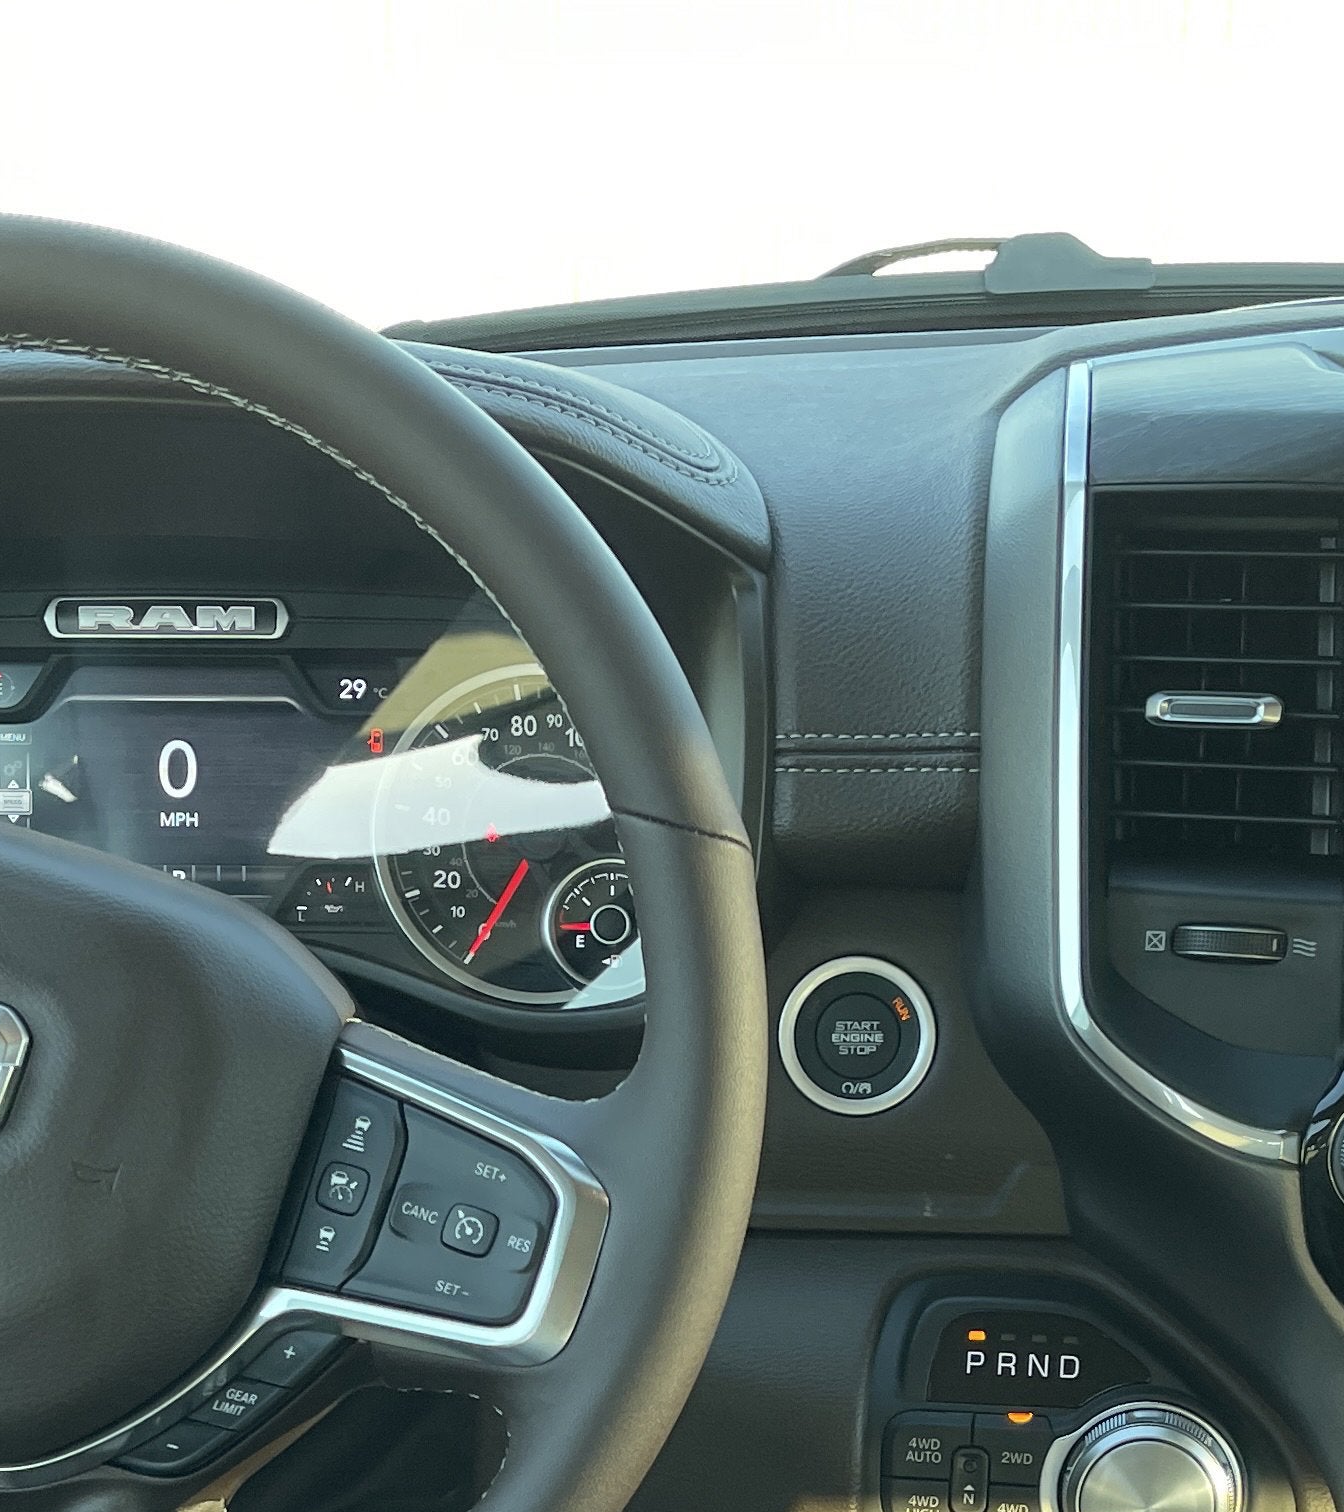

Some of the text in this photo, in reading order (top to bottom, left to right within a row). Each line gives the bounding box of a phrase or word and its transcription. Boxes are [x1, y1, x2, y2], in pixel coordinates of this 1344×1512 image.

[76, 603, 256, 632] RAM
[338, 679, 367, 700] 29
[510, 714, 538, 737] 80
[546, 713, 564, 728] 90
[0, 733, 26, 742] MENU
[481, 727, 499, 742] 70
[451, 750, 479, 767] 60
[158, 738, 198, 799] 0
[159, 812, 199, 828] MPH
[422, 806, 451, 826] 40
[433, 870, 461, 889] 20
[450, 905, 466, 918] 10
[575, 934, 586, 949] E
[891, 996, 911, 1022] RUN
[835, 1020, 880, 1031] START
[831, 1032, 885, 1044] ENGINE
[838, 1045, 878, 1055] STOP
[400, 1200, 439, 1225] CANC
[507, 1234, 532, 1254] RES
[225, 1387, 258, 1406] GEAR
[212, 1399, 246, 1417] LIMIT
[907, 1437, 941, 1452] 4WD
[905, 1449, 942, 1465] AUTO
[1001, 1451, 1033, 1465] 2WD
[907, 1494, 940, 1508] 4WD
[962, 1493, 975, 1505] N
